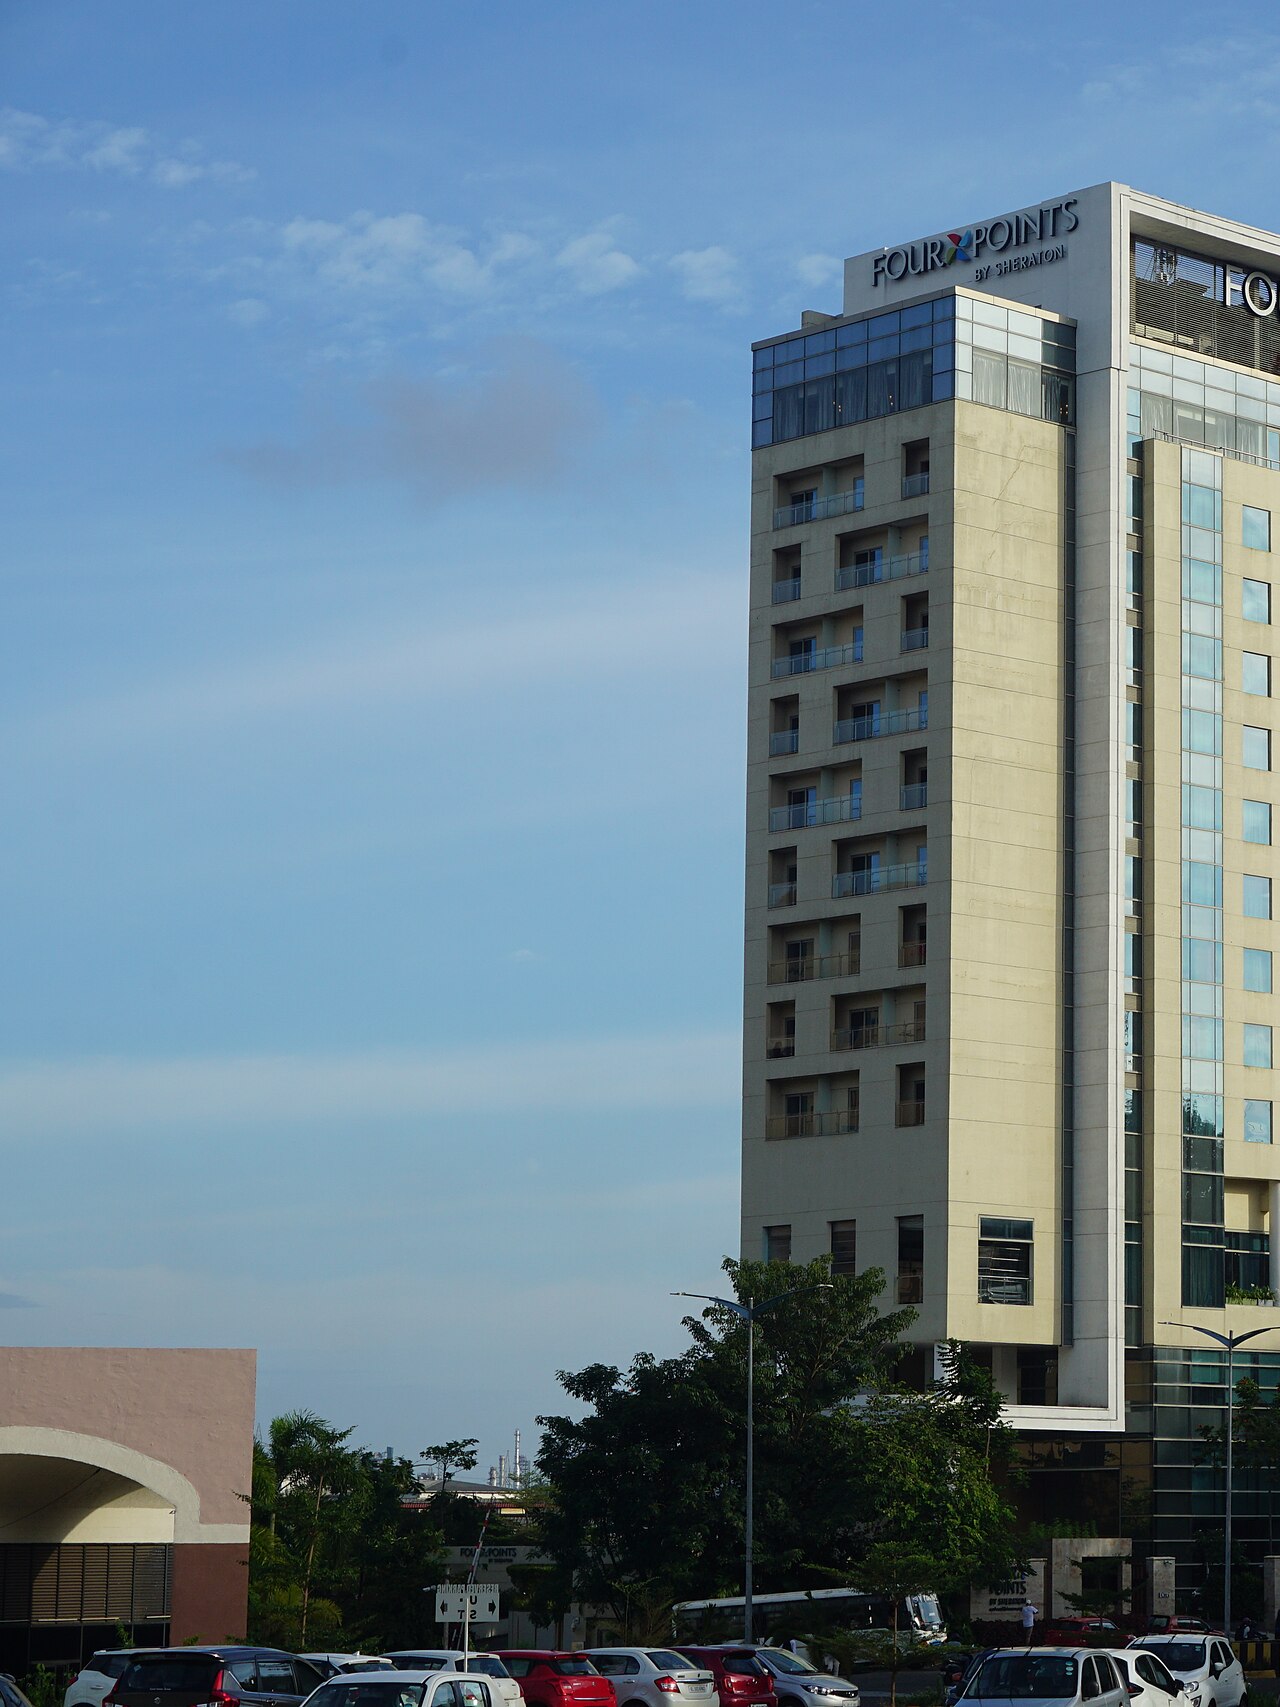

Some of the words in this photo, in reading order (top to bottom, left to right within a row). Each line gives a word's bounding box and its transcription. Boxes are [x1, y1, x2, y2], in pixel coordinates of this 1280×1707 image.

[872, 239, 947, 287] FOUR
[973, 199, 1079, 258] POINTS
[974, 267, 991, 282] BY
[996, 244, 1066, 276] SHERATON
